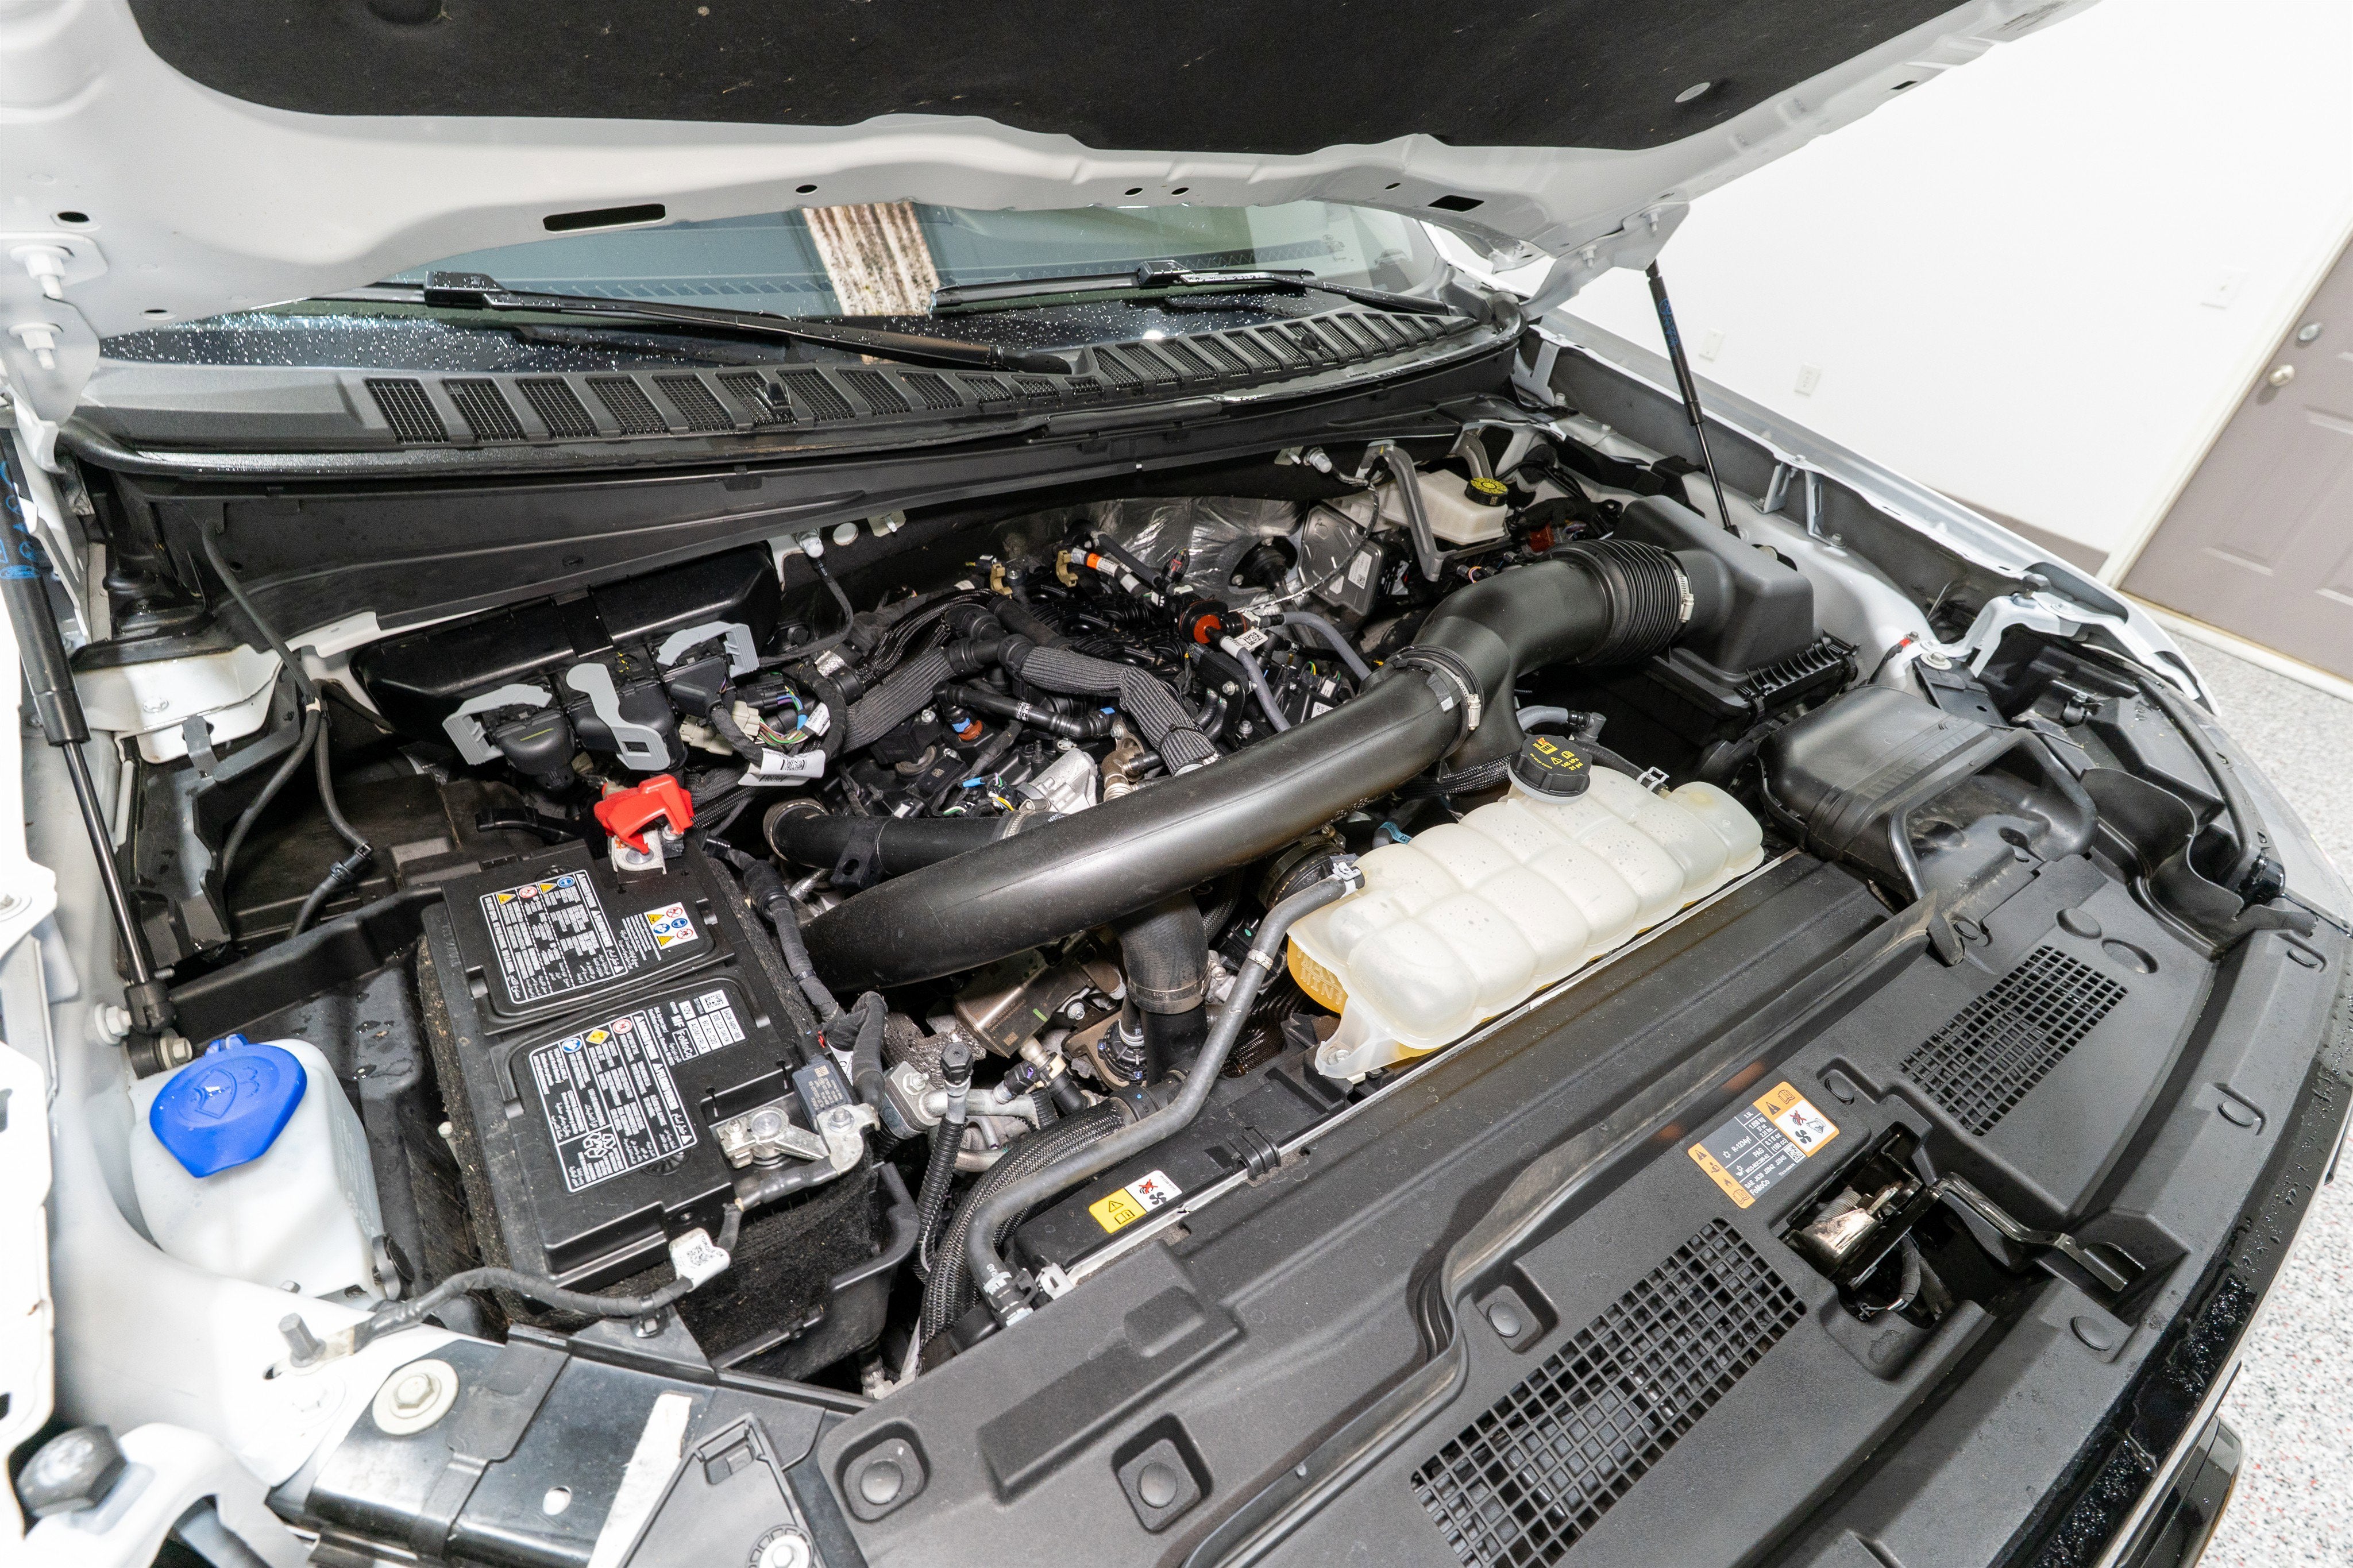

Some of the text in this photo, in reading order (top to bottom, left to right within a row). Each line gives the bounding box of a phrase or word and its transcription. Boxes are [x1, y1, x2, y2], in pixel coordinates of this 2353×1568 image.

[1299, 967, 1334, 1000] MIN
[683, 1005, 692, 1014] 12V
[676, 1030, 692, 1058] FoMoCo
[1748, 1119, 1760, 1129] 1.050
[1760, 1129, 1768, 1137] 2.31
[1731, 1136, 1751, 1152] R-1234yf
[1752, 1148, 1764, 1157] PAG
[1744, 1180, 1754, 1188] SAE
[1750, 1180, 1770, 1195] FoMoCo
